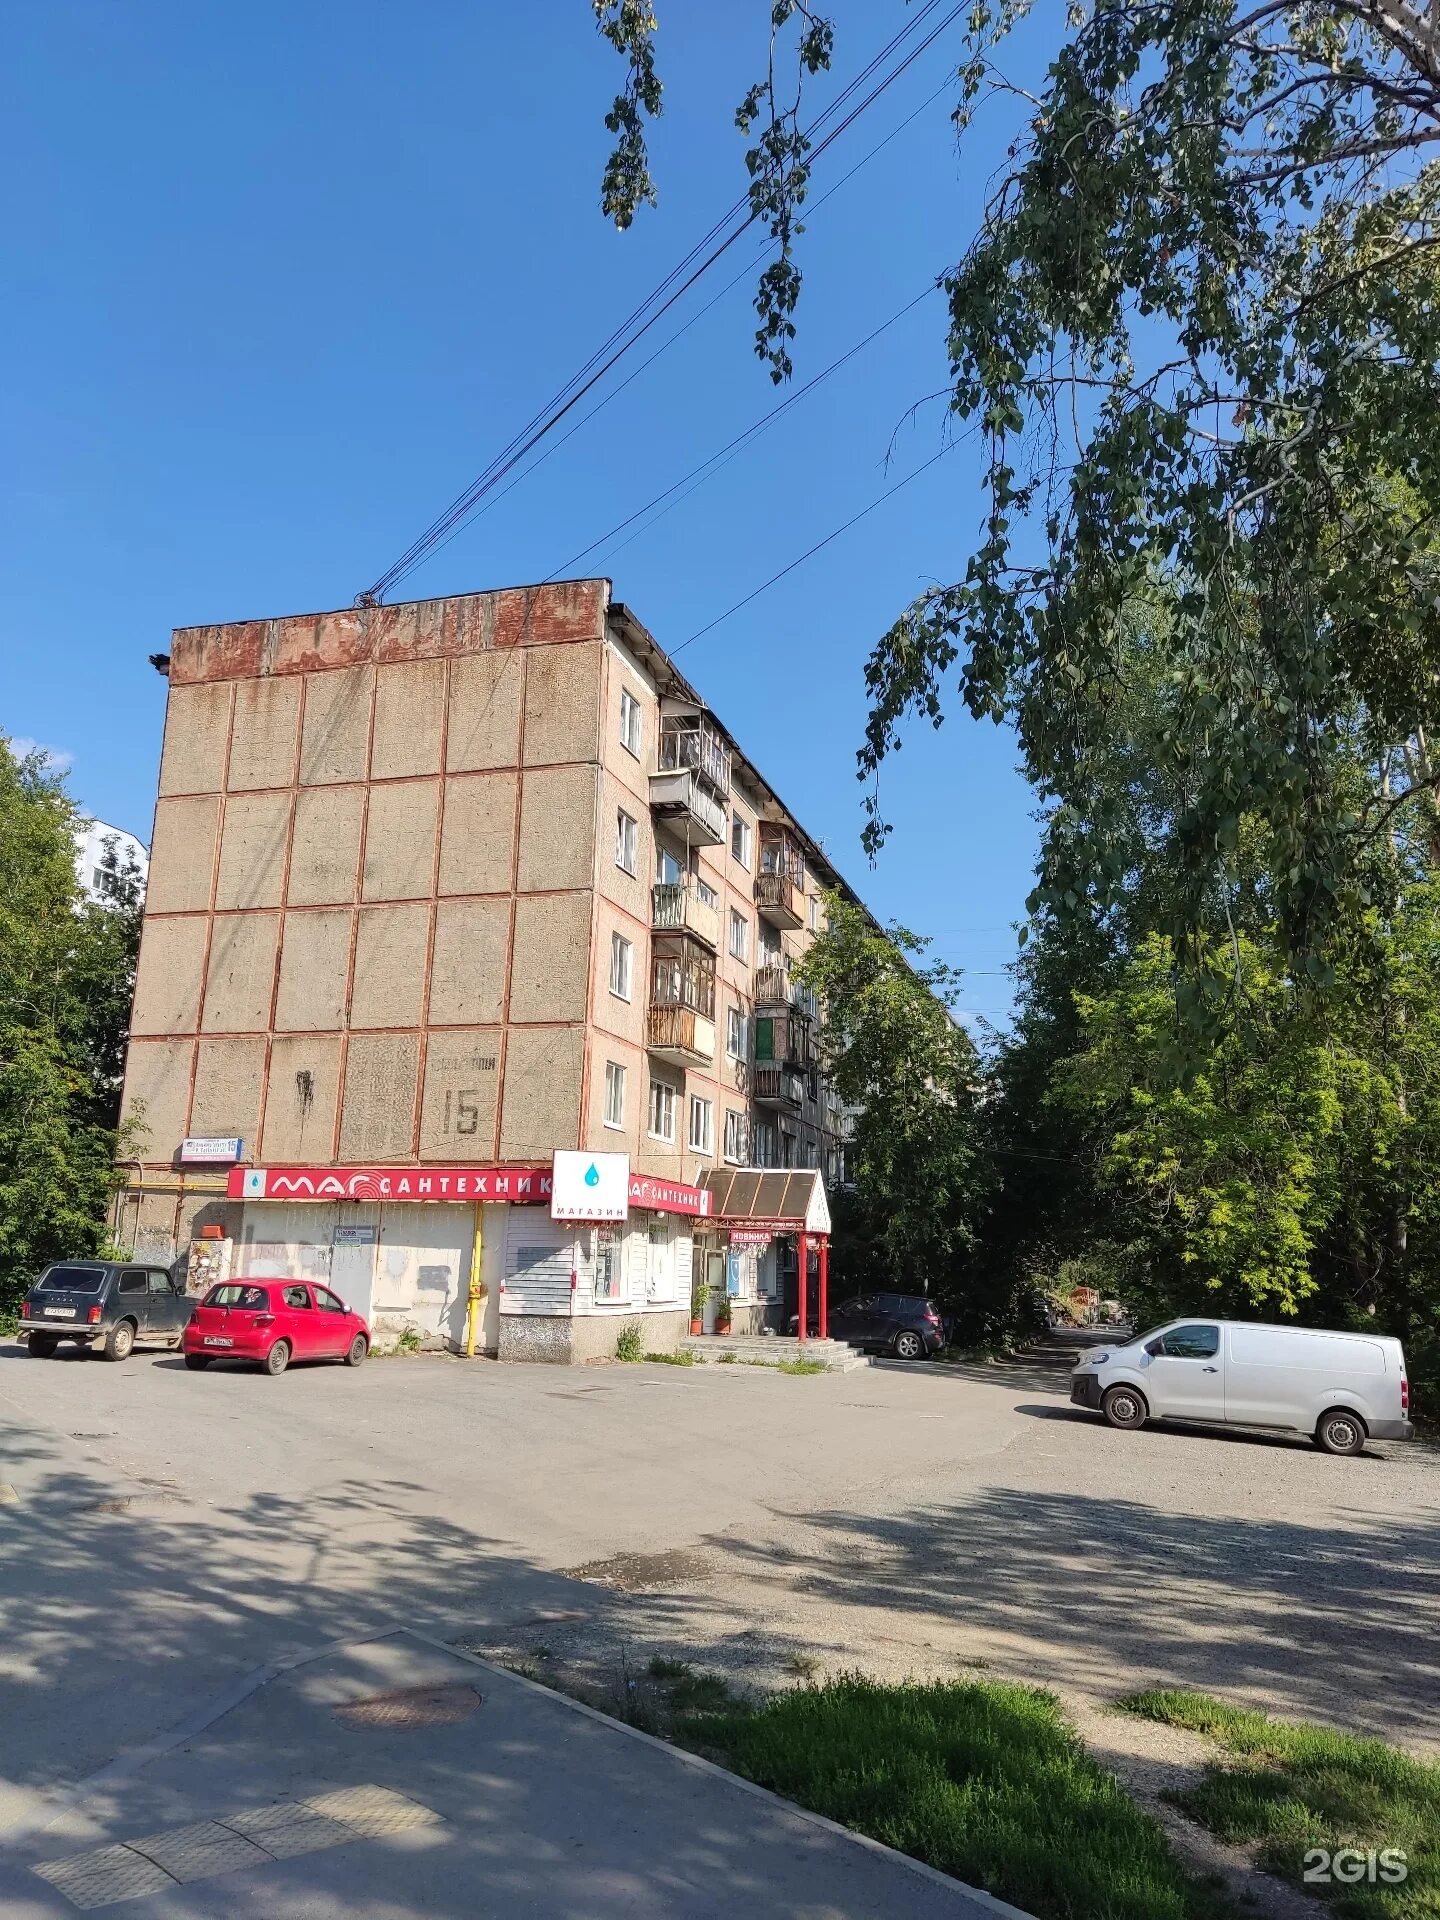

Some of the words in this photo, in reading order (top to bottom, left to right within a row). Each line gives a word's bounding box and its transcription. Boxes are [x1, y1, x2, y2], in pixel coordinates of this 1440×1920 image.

[227, 1140, 236, 1152] 15
[271, 1175, 370, 1195] МАГ
[379, 1177, 552, 1194] САНТЕХНИК
[629, 1181, 649, 1198] АГ
[651, 1186, 699, 1207] САНТЕХНИК
[556, 1207, 624, 1217] МАГАЗИН
[733, 1232, 770, 1241] НОВИНКА
